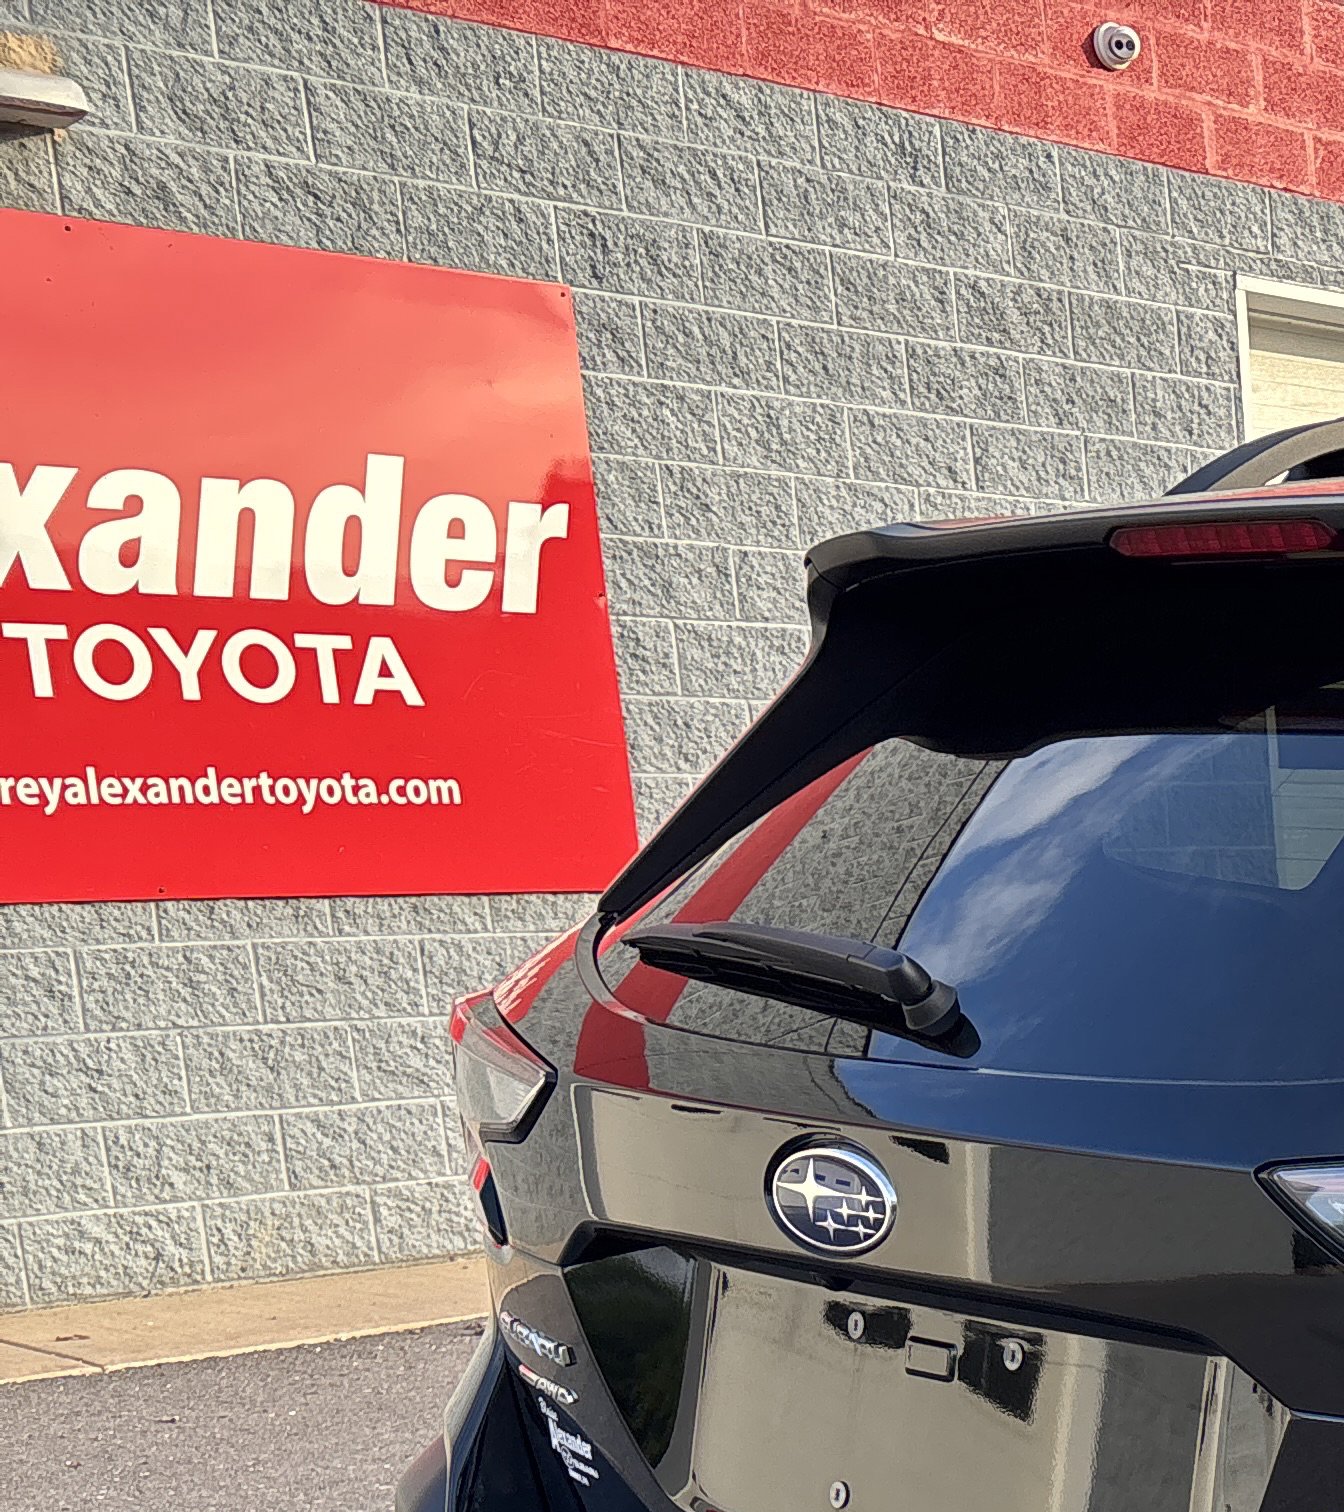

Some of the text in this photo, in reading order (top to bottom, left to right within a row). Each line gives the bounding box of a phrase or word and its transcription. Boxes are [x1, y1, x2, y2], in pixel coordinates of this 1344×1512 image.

[0, 454, 569, 614] xander
[1, 621, 426, 707] TOYOTA
[0, 766, 462, 816] reyalexandertoyota.com
